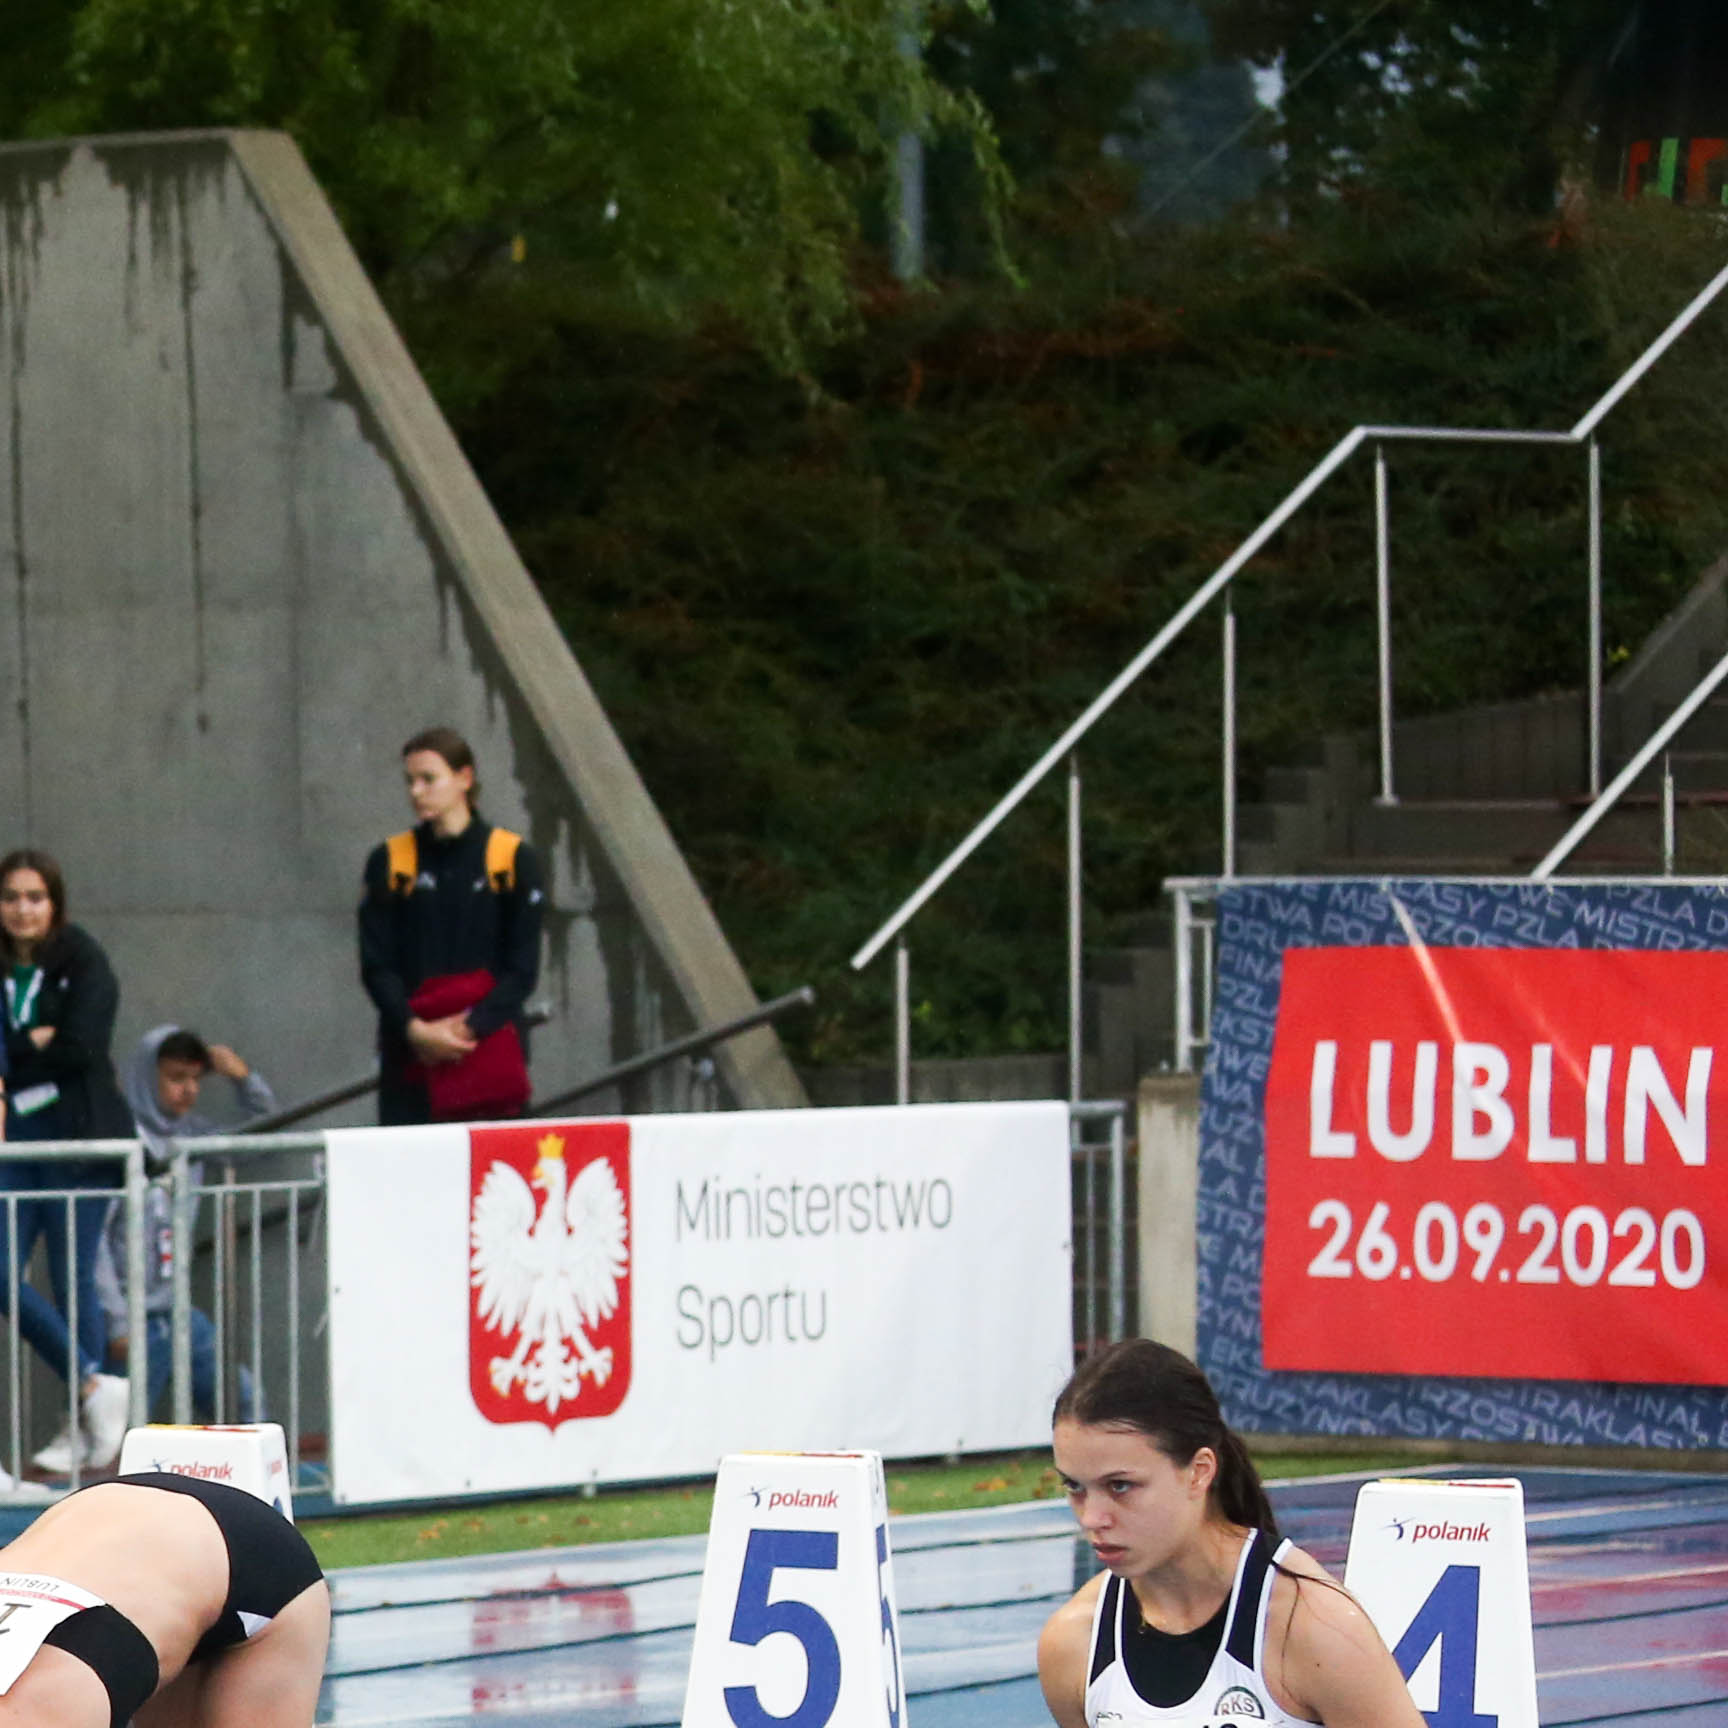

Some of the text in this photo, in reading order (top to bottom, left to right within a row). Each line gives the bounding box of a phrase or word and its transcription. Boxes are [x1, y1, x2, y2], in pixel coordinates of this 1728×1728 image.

[1310, 1039, 1714, 1167] LUBLIN
[674, 1173, 953, 1242] Ministerstwo
[1306, 1200, 1706, 1290] 26.09.2020
[675, 1283, 828, 1363] Sportu
[768, 1488, 839, 1511] polanik
[1412, 1521, 1491, 1543] polanik
